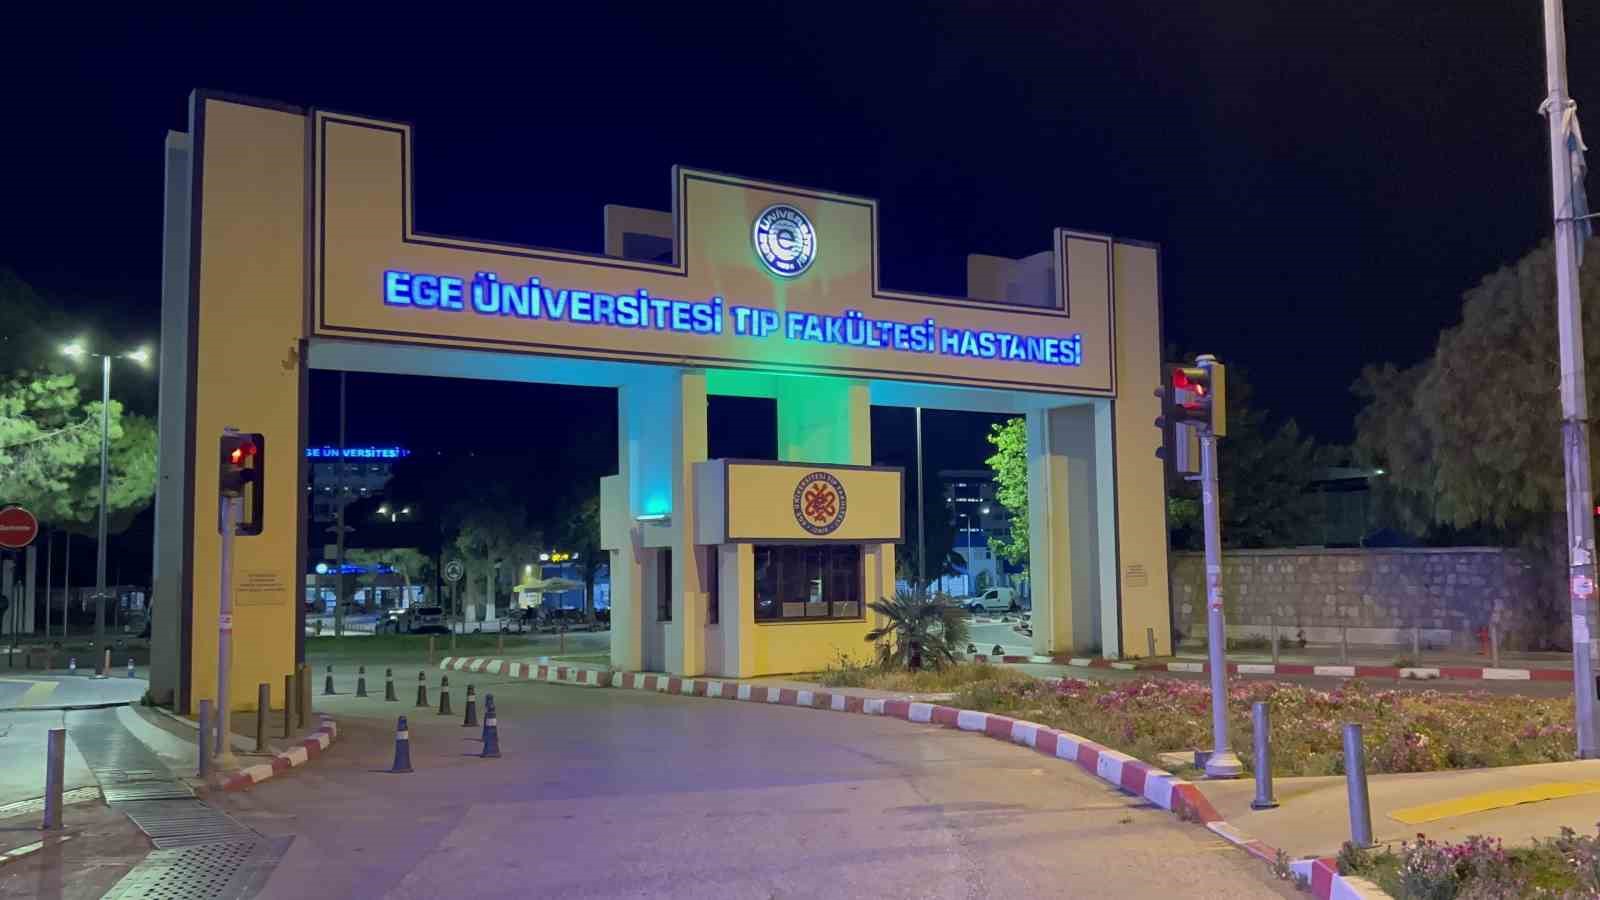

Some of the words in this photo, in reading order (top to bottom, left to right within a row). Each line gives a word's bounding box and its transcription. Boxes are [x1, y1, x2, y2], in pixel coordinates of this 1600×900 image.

[384, 270, 465, 310] EGE
[472, 271, 724, 335] ÜNİVERSİTESİ
[732, 306, 780, 338] TIP
[785, 310, 936, 353] FAKÜLTESİ
[941, 326, 1083, 367] HASTANESİ
[322, 445, 400, 458] ÜNVERSİTESİ
